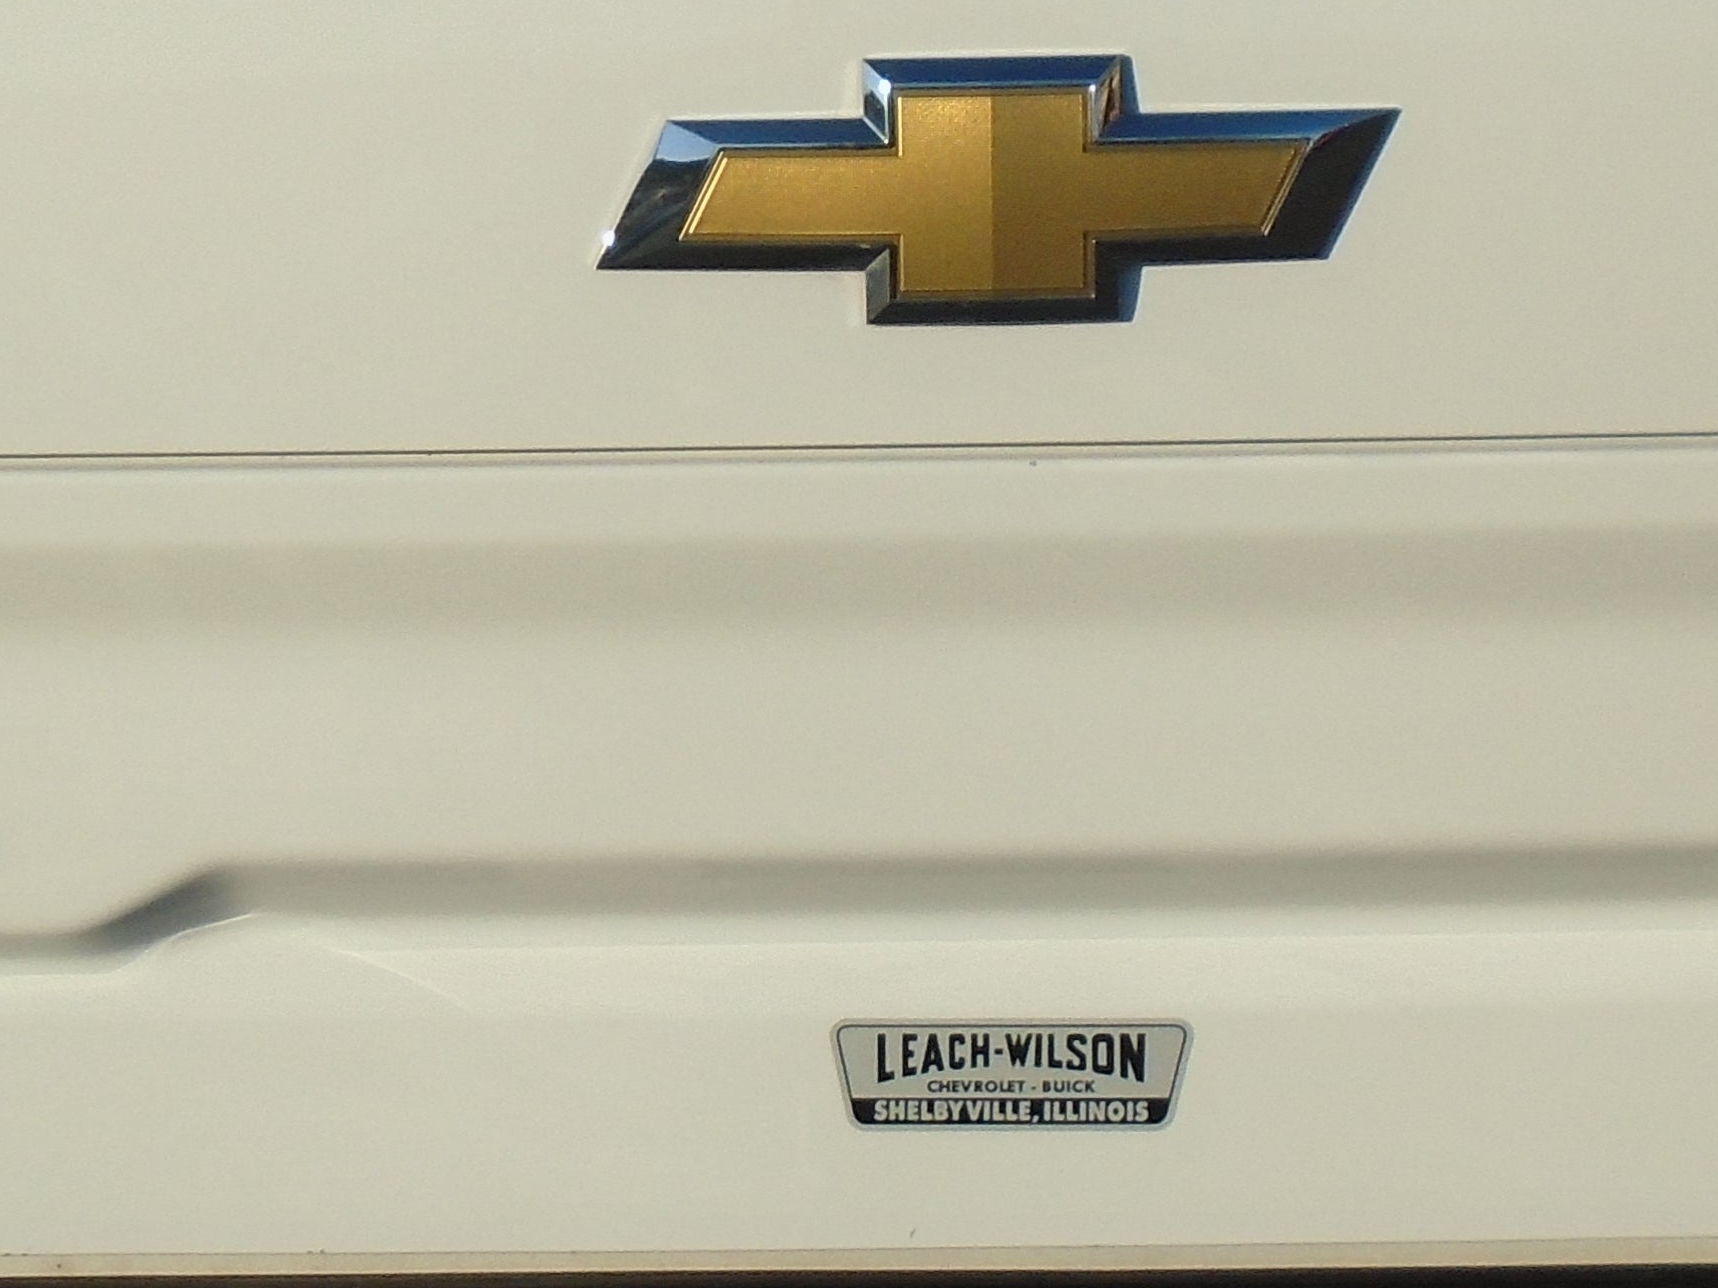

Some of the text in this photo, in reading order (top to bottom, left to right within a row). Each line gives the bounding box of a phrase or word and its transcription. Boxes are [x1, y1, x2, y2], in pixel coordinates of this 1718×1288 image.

[876, 1032, 1147, 1083] LEACH-WILSON
[927, 1079, 1026, 1093] CHEVROLET
[1042, 1079, 1096, 1093] BUICK
[1043, 1099, 1149, 1123] ILLINOIS
